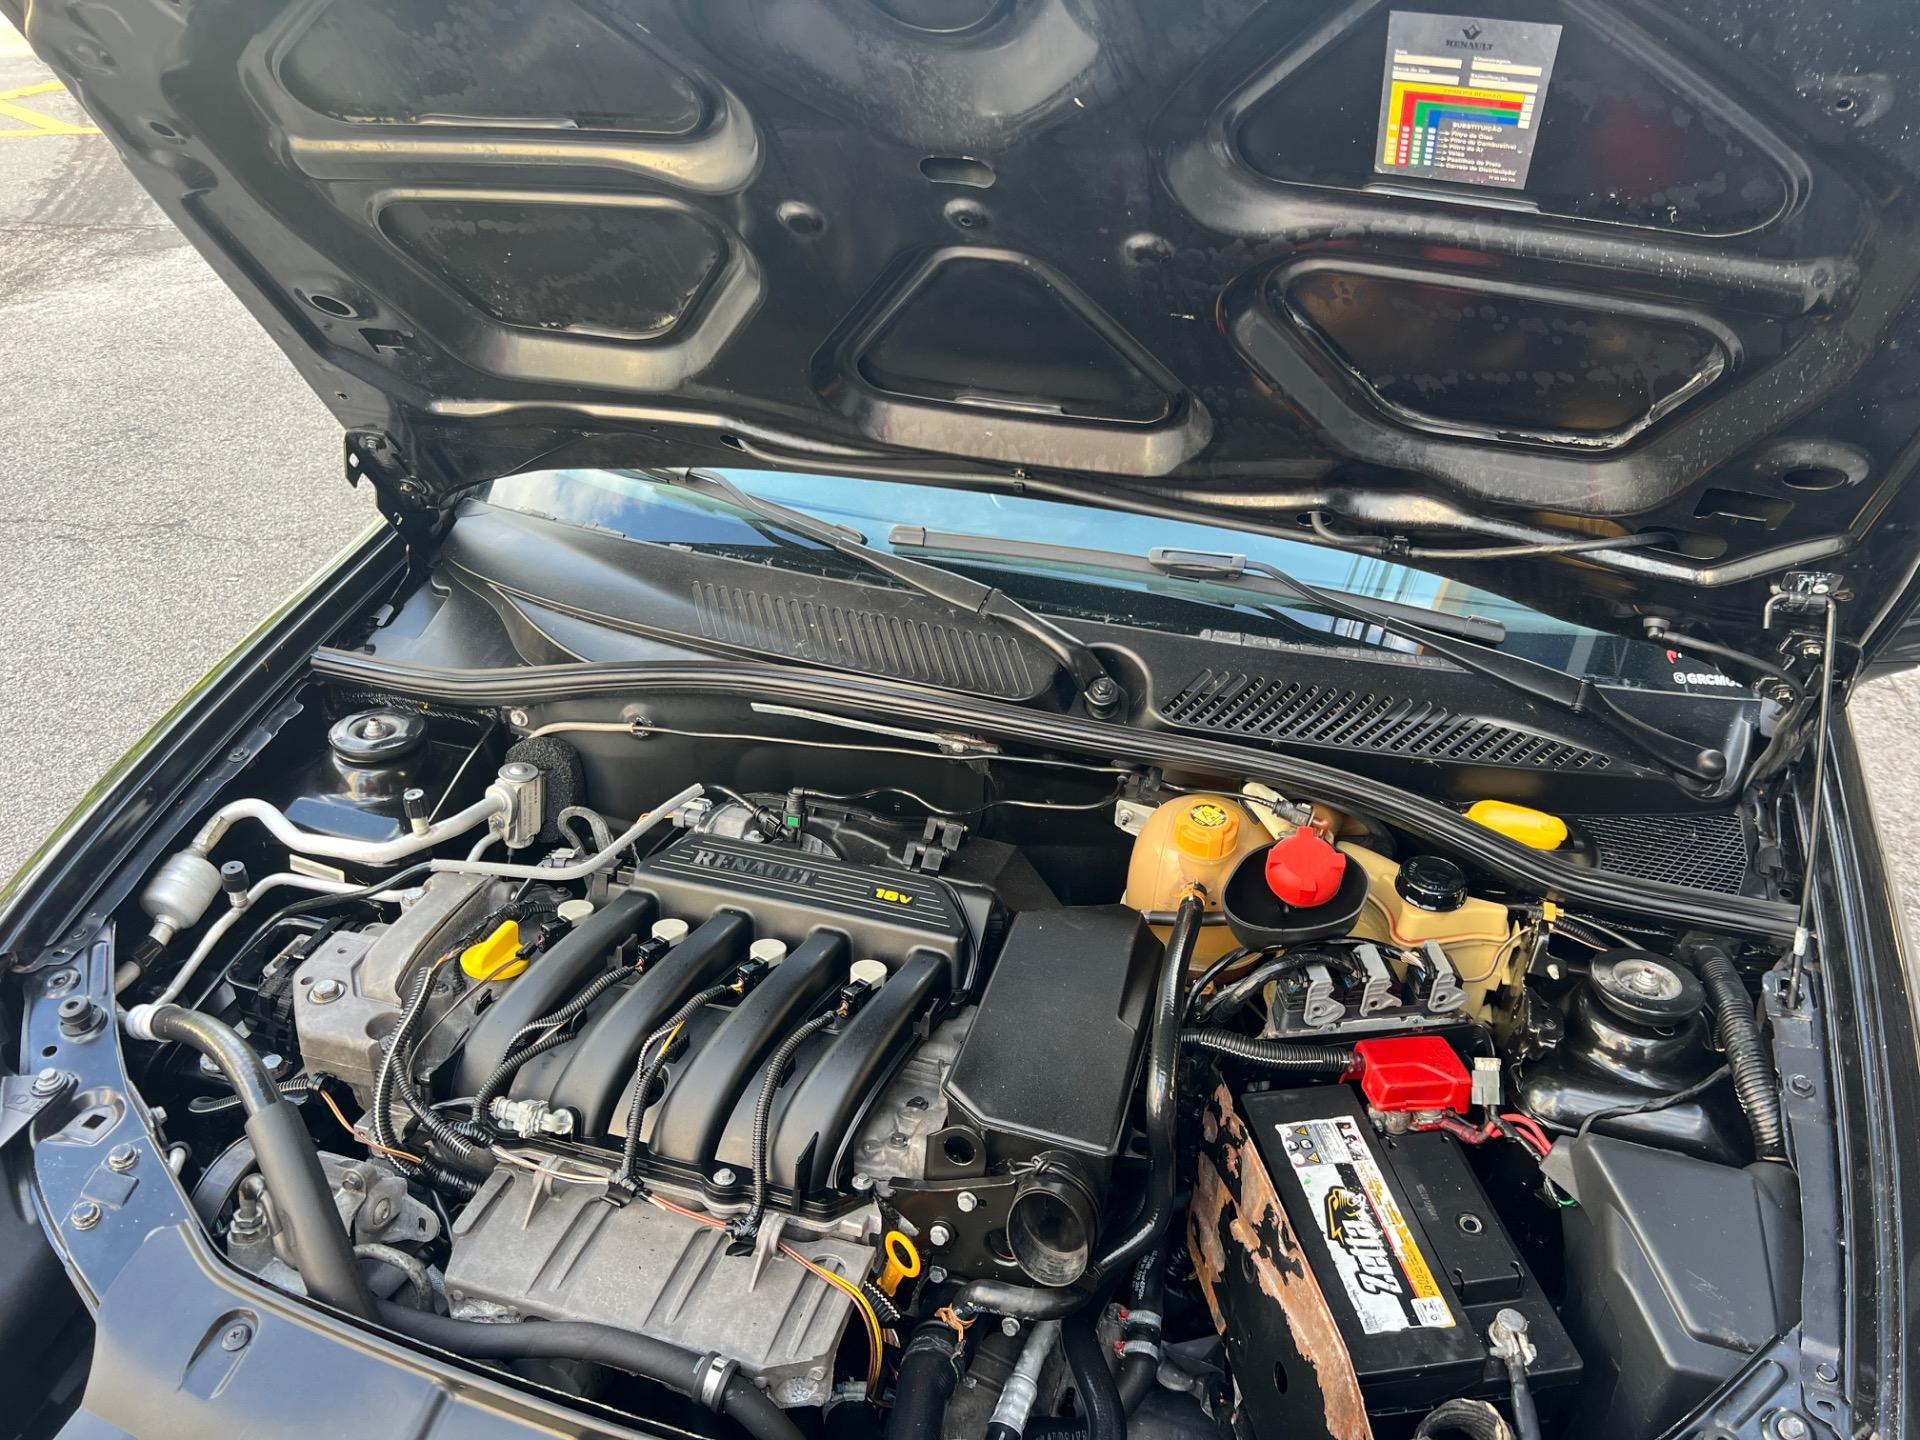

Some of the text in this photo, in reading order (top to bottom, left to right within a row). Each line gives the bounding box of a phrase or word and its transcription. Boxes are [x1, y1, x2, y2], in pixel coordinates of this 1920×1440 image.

[1445, 40, 1493, 51] RENAULT
[692, 850, 816, 886] RENAULT
[1340, 1219, 1403, 1295] Zetta
